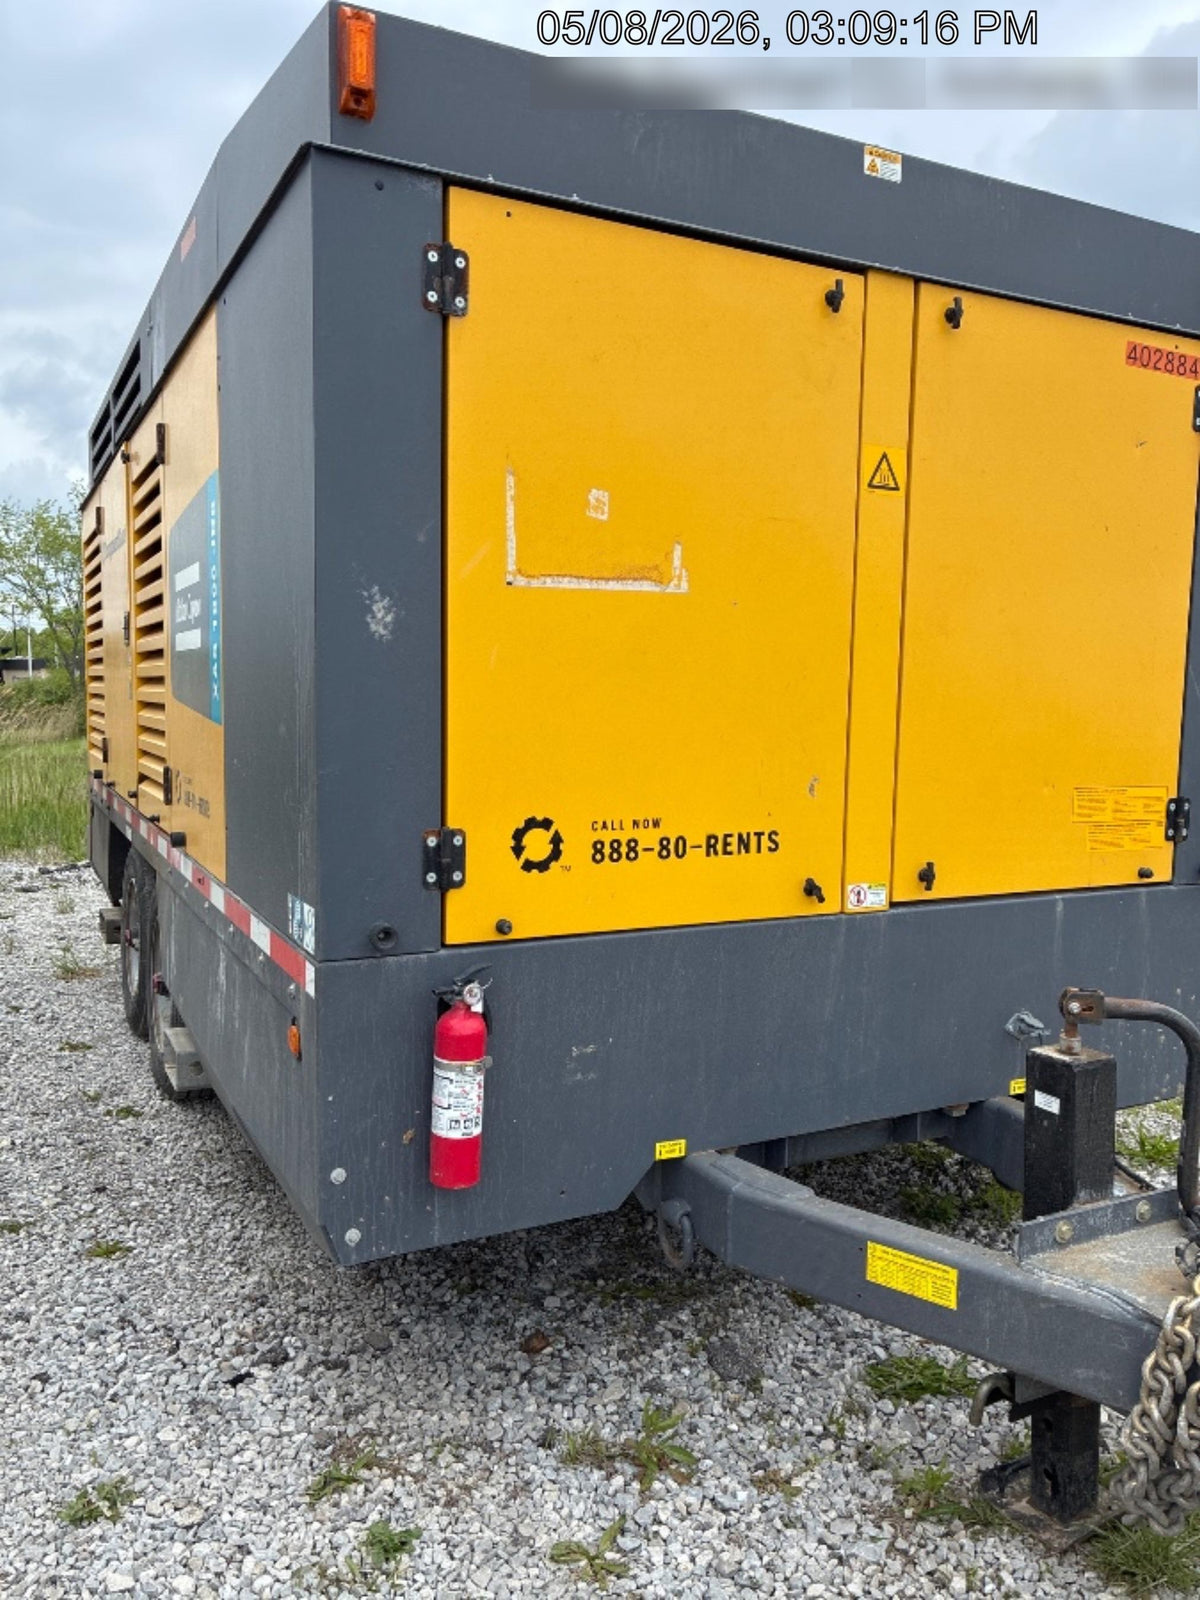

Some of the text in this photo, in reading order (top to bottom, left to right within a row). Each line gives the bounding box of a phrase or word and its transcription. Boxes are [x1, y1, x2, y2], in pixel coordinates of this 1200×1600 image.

[1127, 344, 1199, 380] 402884
[591, 817, 662, 832] CALL NOW
[591, 829, 780, 865] 888-80-RENTS
